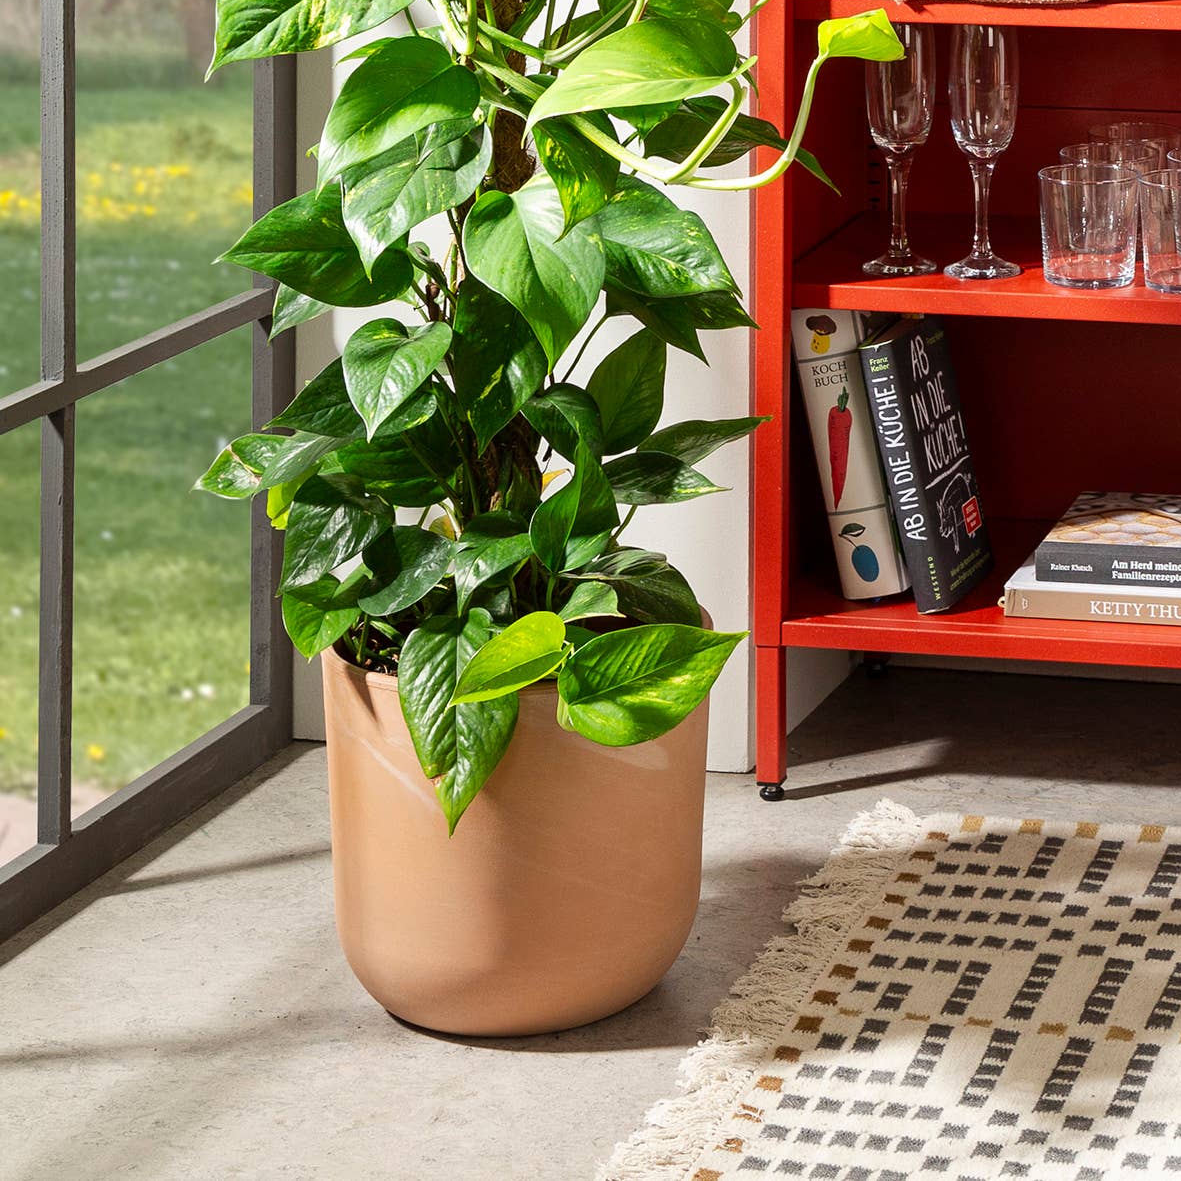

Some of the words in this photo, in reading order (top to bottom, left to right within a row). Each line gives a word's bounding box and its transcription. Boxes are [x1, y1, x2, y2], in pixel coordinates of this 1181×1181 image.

[811, 360, 847, 376] KOCH
[869, 356, 889, 366] Franz
[910, 335, 929, 381] AB
[814, 372, 849, 388] BUCH
[911, 390, 929, 431] IN
[927, 371, 951, 419] DIE
[923, 411, 968, 473] KÜCHE!
[889, 451, 913, 485] DIE
[897, 487, 919, 510] IN
[904, 513, 928, 540] AB
[1112, 560, 1128, 569] Am
[1130, 560, 1152, 570] Herd
[927, 556, 941, 601] WESTEND
[1090, 600, 1144, 616] KETTY
